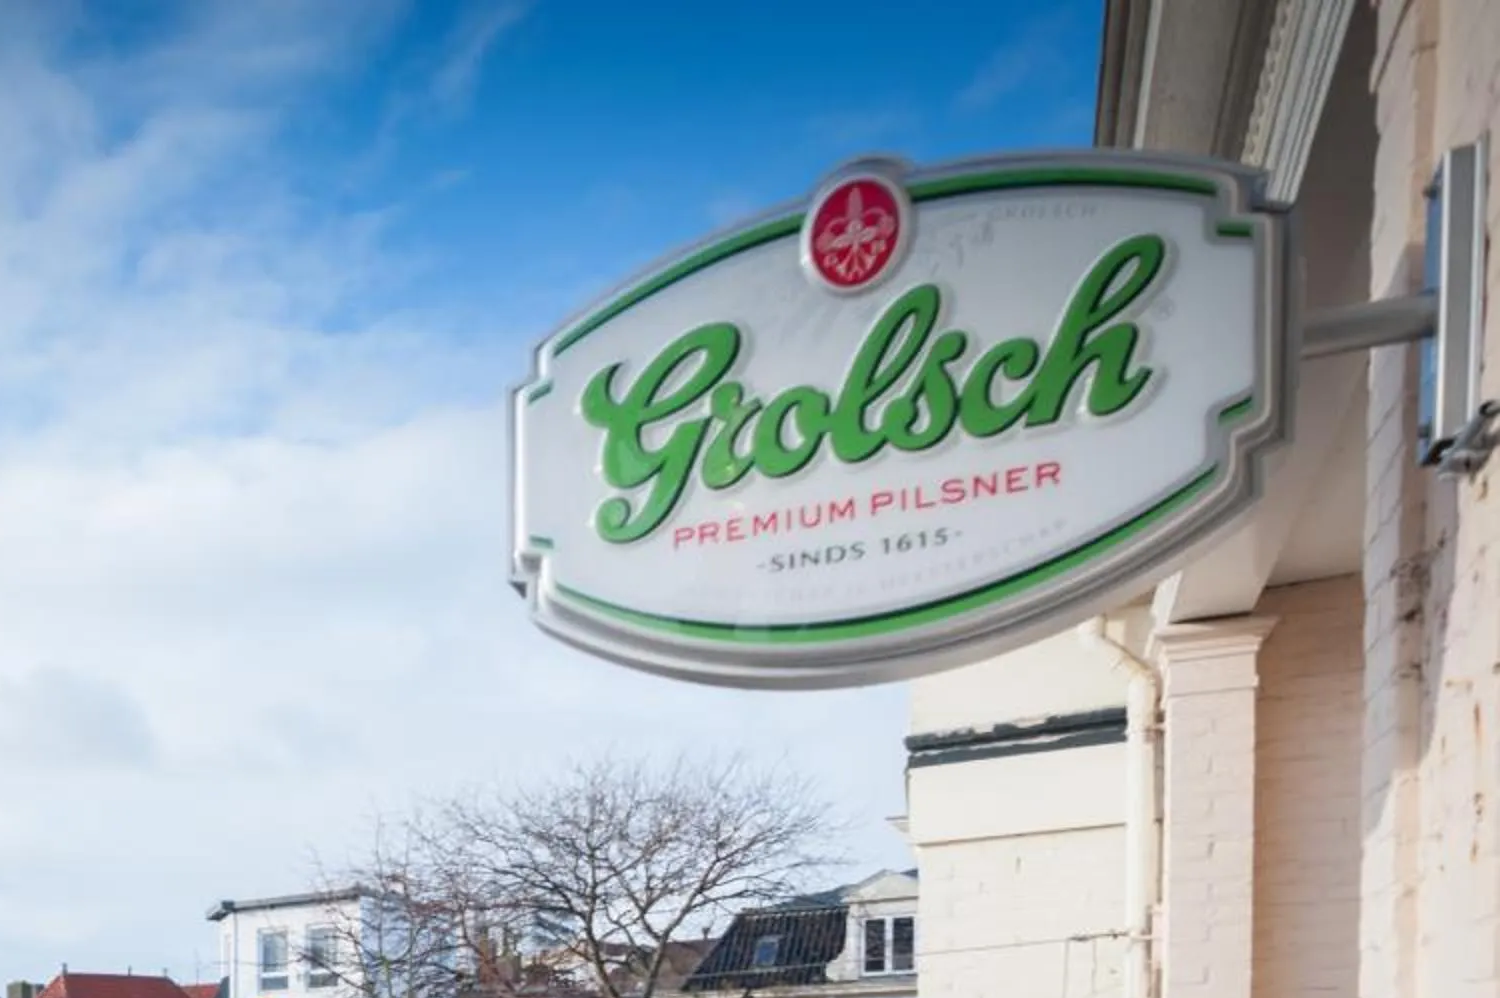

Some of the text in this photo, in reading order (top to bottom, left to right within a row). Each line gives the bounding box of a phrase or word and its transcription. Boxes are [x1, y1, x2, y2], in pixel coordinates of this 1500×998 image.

[580, 233, 1166, 543] Grolsch
[673, 461, 1062, 550] PREMIUM PILSNER
